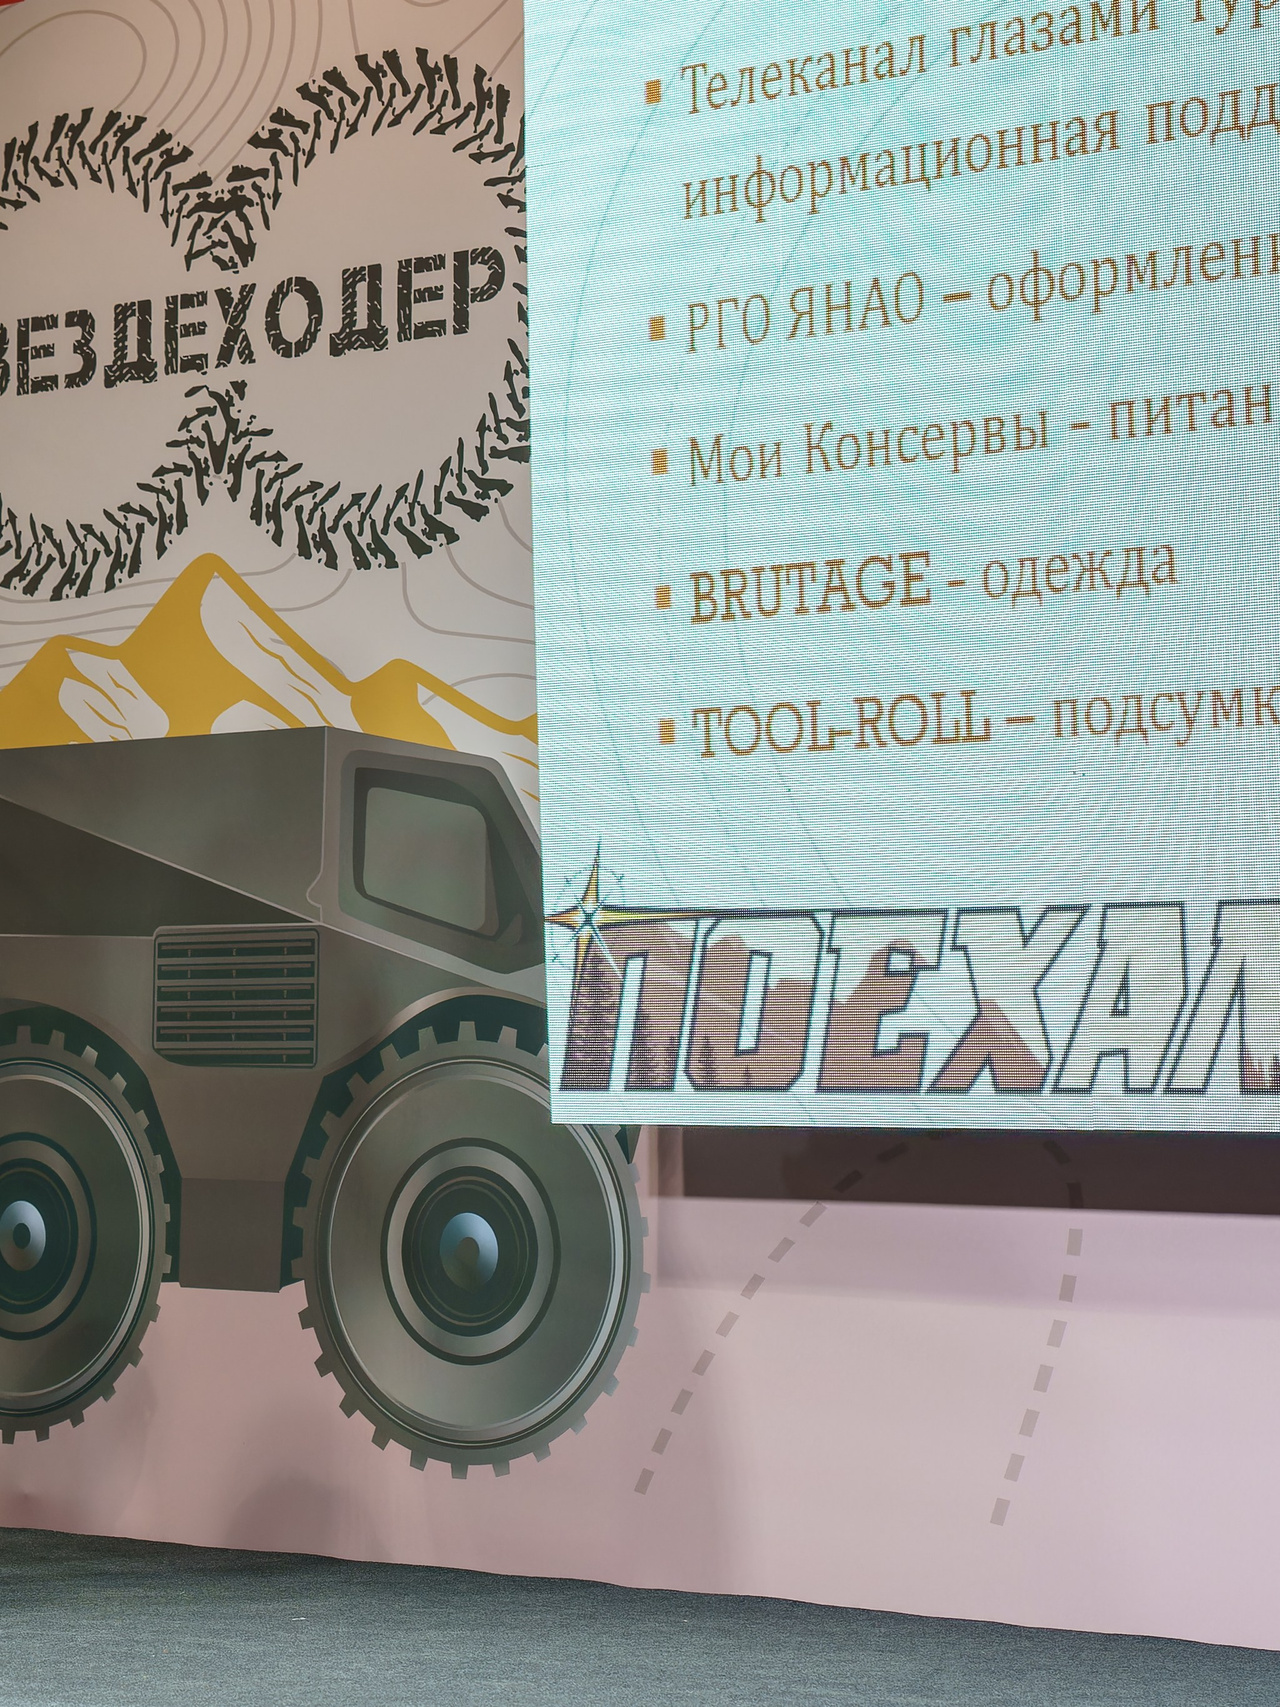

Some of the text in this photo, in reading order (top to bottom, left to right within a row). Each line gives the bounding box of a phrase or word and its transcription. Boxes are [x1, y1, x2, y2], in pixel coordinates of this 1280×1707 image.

[679, 34, 927, 115] Телеканал
[947, 0, 1160, 69] глазами
[682, 83, 1280, 223] информационная подд
[686, 292, 771, 353] РГО
[786, 270, 926, 341] ЯНАО
[689, 434, 783, 487] Мои
[803, 408, 1050, 475] Консервы
[1109, 384, 1272, 441] питан
[689, 550, 932, 625] BRUTAGE
[982, 542, 1178, 606] одежда
[692, 689, 992, 759] TOOL-ROLL
[1053, 685, 1280, 747] подсумк
